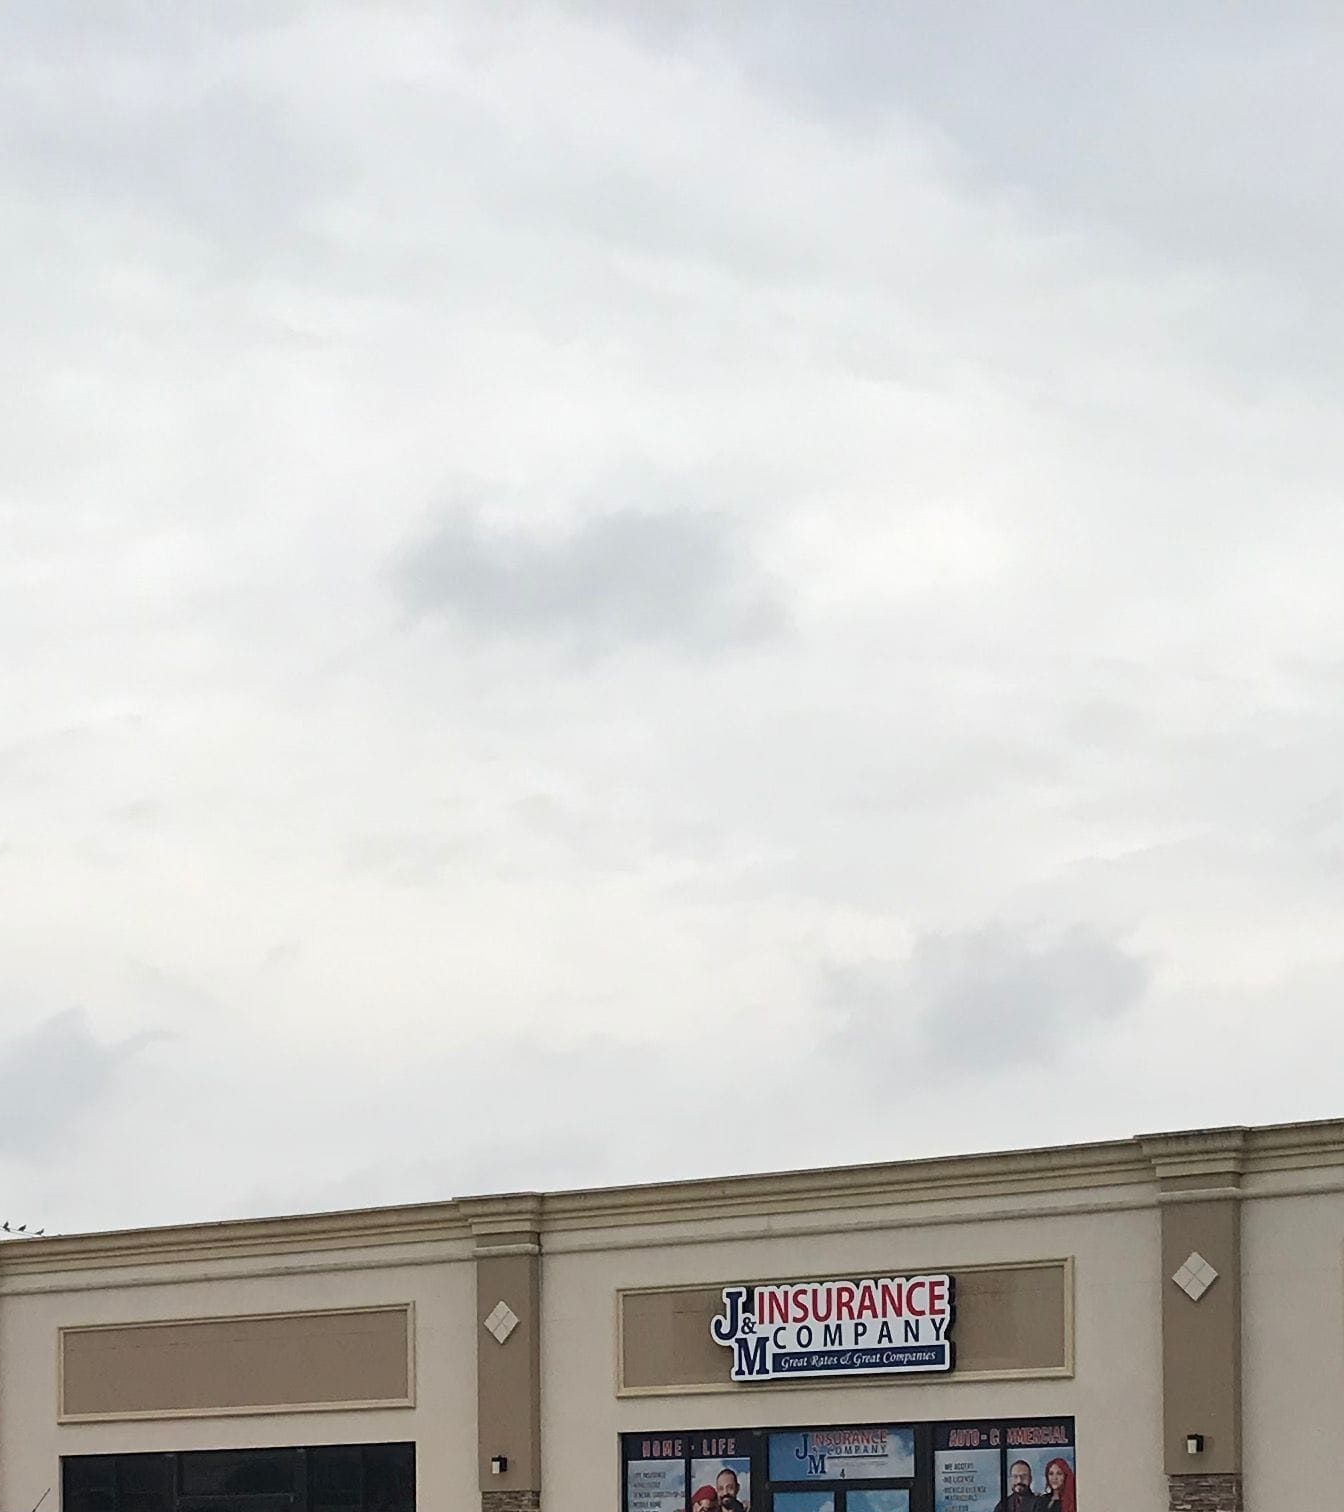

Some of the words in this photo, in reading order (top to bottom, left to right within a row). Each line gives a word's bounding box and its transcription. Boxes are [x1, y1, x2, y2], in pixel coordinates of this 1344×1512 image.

[758, 1280, 945, 1325] INSURANCE
[773, 1319, 946, 1350] COMPANY
[781, 1356, 808, 1371] Great
[810, 1354, 838, 1369] Rates
[853, 1350, 880, 1366] Great
[883, 1350, 937, 1366] Companies
[642, 1440, 682, 1457] HOME
[702, 1438, 736, 1456] LIFE
[812, 1430, 888, 1446] INSURANCE
[949, 1429, 980, 1447] AUTO
[827, 1445, 887, 1456] COMPANY
